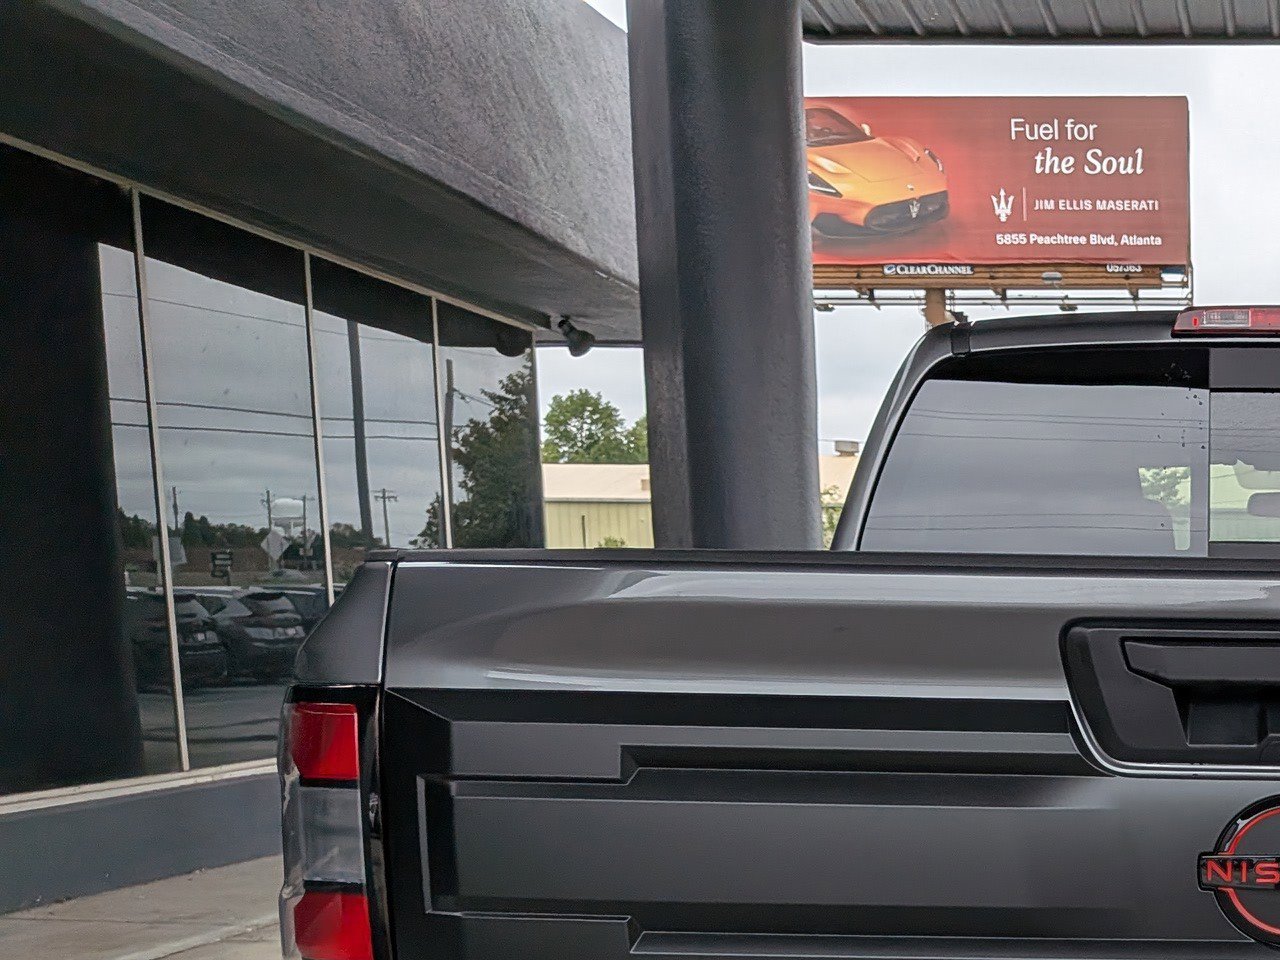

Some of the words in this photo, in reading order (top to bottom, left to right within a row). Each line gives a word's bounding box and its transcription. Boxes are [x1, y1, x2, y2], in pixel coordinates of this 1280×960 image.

[1010, 118, 1058, 141] Fuel
[1065, 118, 1098, 140] for
[1034, 148, 1075, 175] the
[1084, 148, 1144, 175] Soul
[1033, 199, 1056, 211] JIM
[1058, 199, 1093, 211] ELLIS
[1096, 199, 1160, 211] MASERATI
[996, 233, 1027, 245] 5855
[1029, 233, 1087, 246] Peachtree
[1120, 233, 1163, 246] Atlanta
